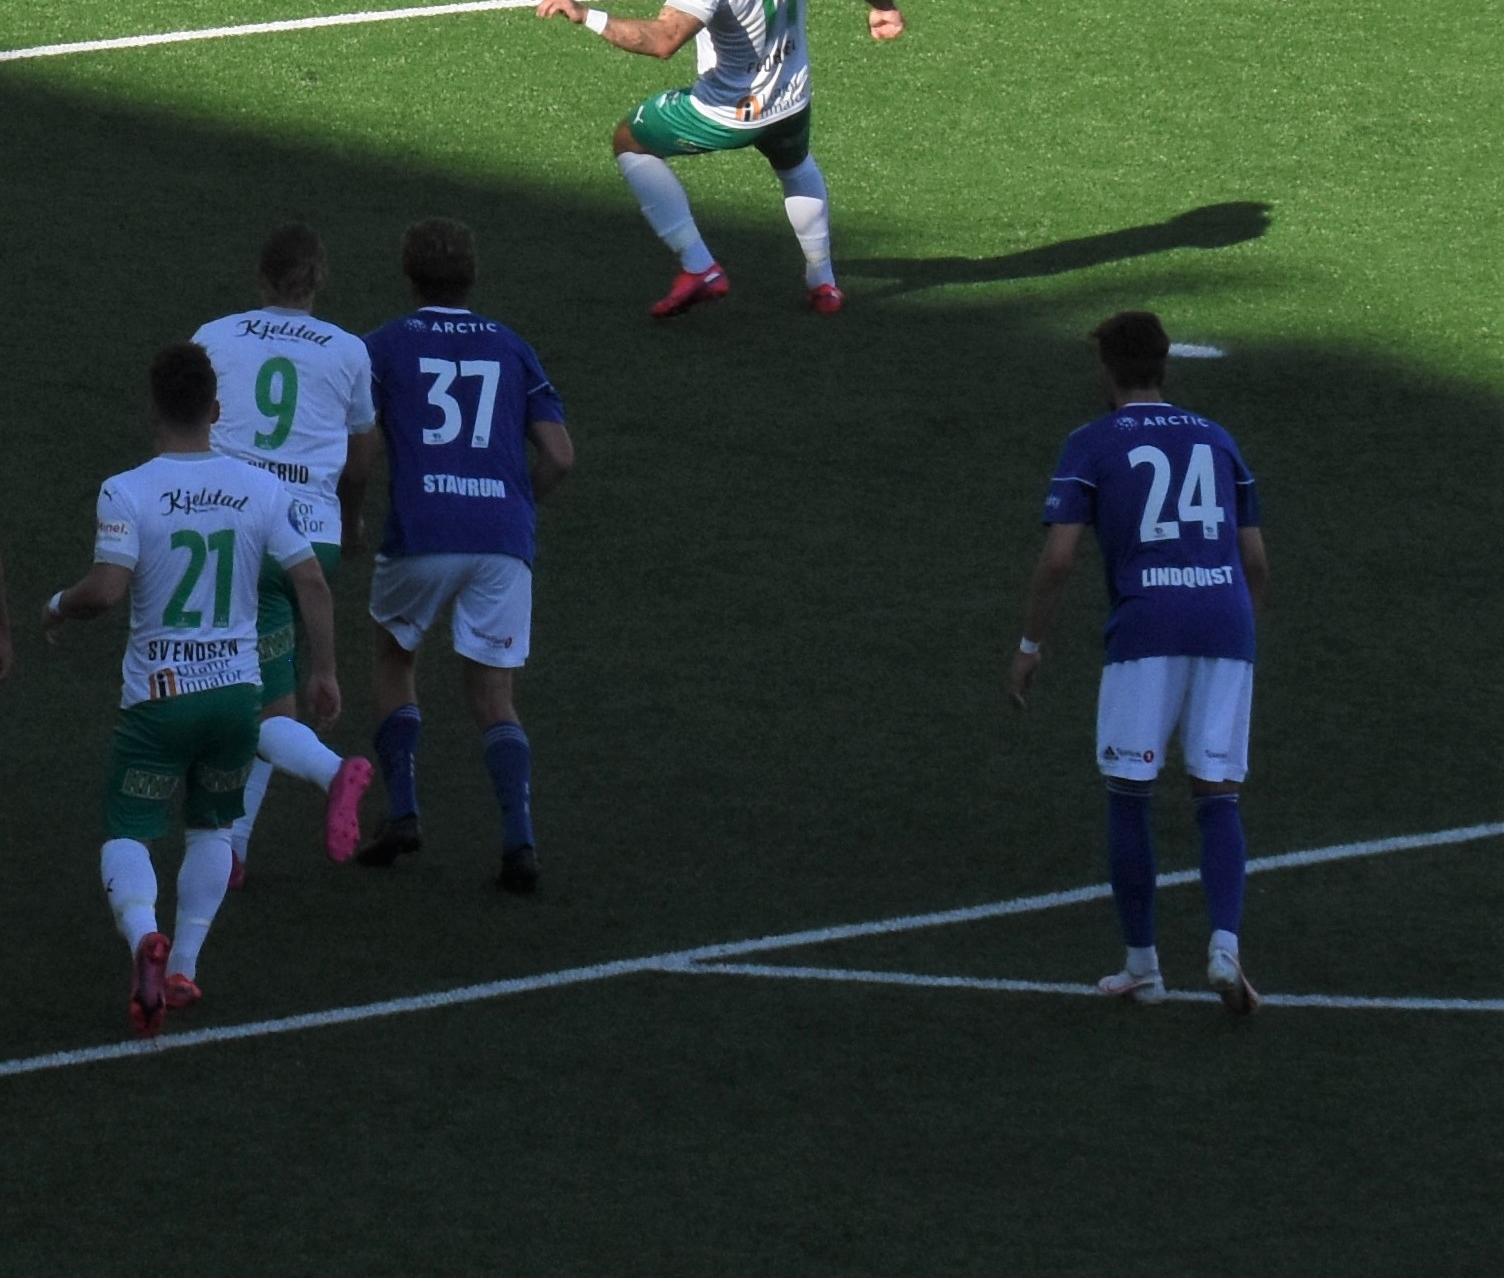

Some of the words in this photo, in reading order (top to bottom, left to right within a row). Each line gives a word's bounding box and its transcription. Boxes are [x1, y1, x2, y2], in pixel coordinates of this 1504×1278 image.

[234, 318, 334, 348] Kjelstad
[431, 321, 498, 334] ARCTIC
[253, 356, 299, 451] 9
[418, 357, 501, 449] 37
[1143, 414, 1210, 429] ARCTIC
[160, 486, 250, 516] Kjelstad
[422, 473, 507, 499] STAVRUM
[1127, 443, 1226, 543] 24
[162, 527, 236, 629] 21
[1141, 564, 1234, 589] LINDQUIST
[147, 638, 240, 663] SVENDSEN
